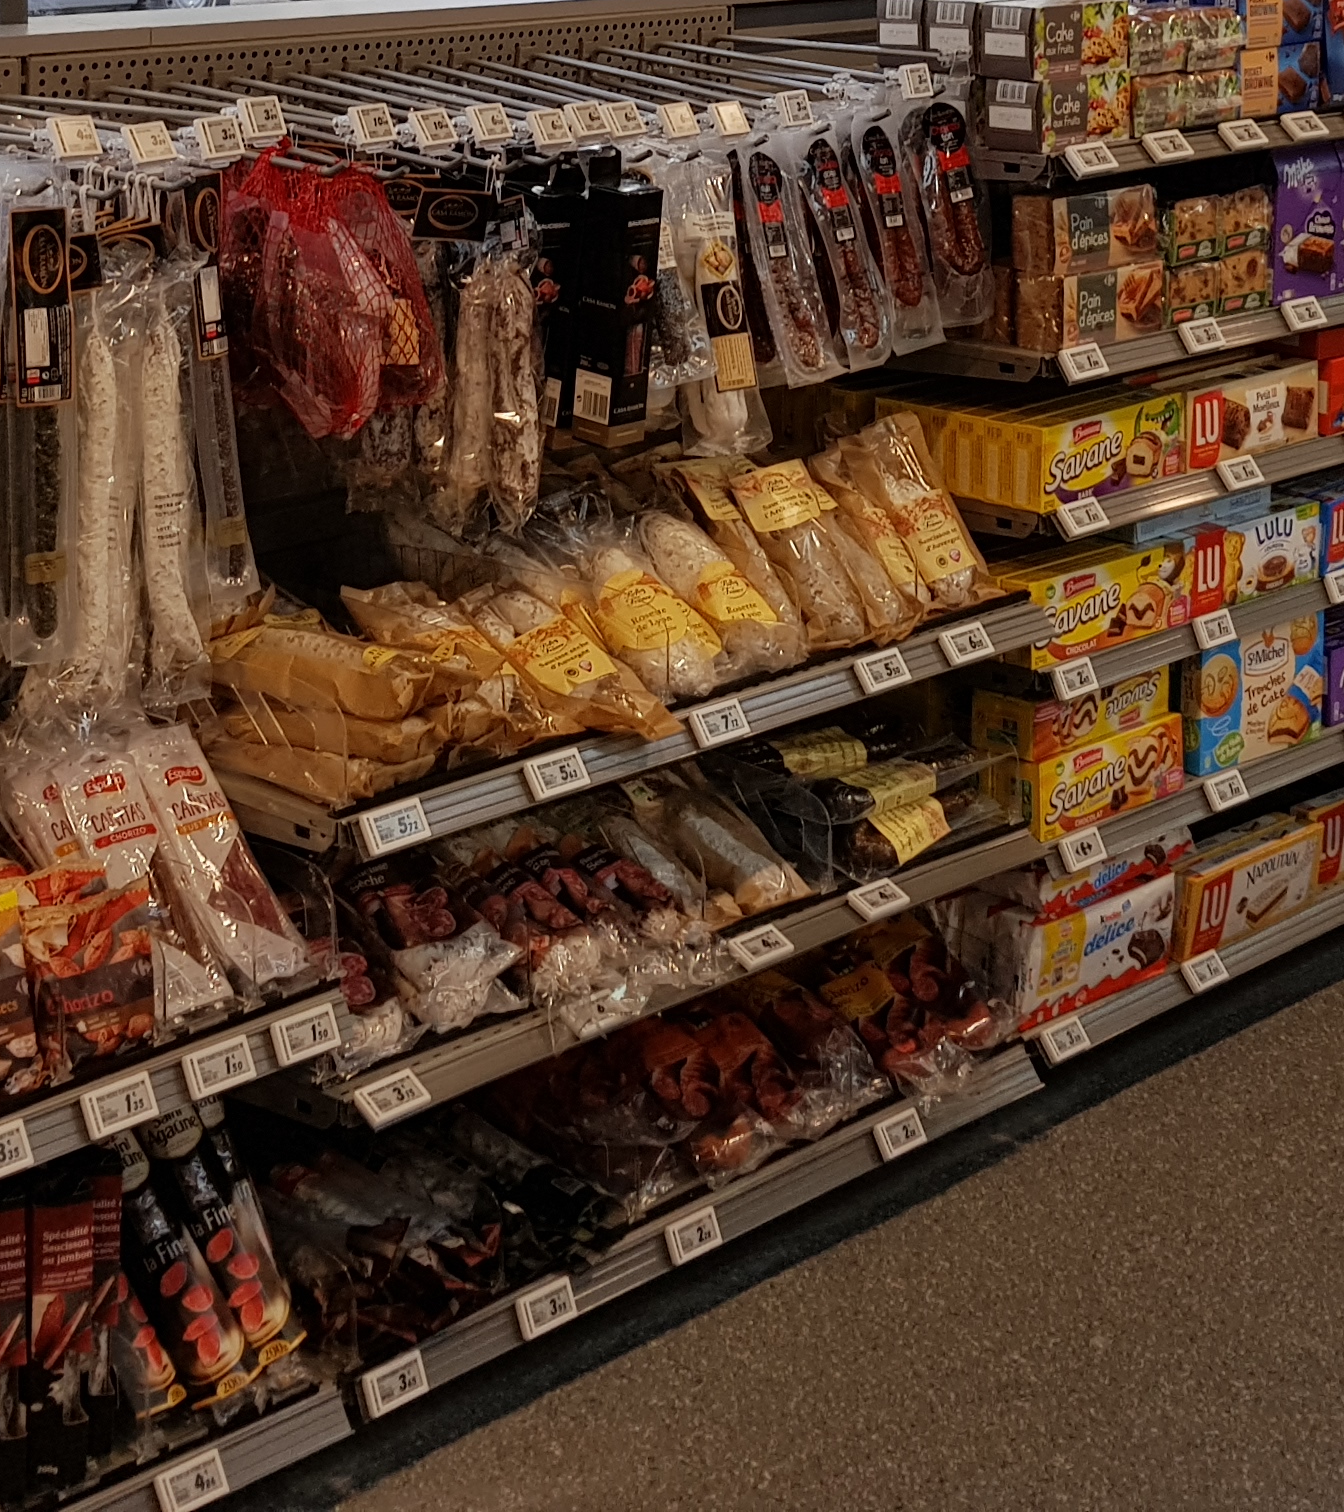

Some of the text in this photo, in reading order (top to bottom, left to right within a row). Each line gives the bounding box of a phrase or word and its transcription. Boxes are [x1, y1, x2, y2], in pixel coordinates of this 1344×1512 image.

[1046, 22, 1074, 43] Cake
[1053, 95, 1081, 116] Cake
[1070, 213, 1094, 231] Pain
[1071, 230, 1109, 250] d'épices
[1079, 290, 1102, 309] Pain
[1079, 307, 1116, 328] d'épices
[1195, 398, 1220, 447] LU
[1044, 431, 1125, 495] Savane
[1255, 517, 1294, 546] LULU
[1198, 544, 1222, 593] LU
[1065, 640, 1098, 657] CHOCOLAT
[1258, 644, 1287, 664] Michel
[1246, 700, 1260, 717] de
[1044, 755, 1127, 825] Savane
[90, 801, 147, 834] CAÑITAS
[1074, 810, 1104, 827] CHOCOLAT
[109, 826, 147, 843] CHORIZO
[1093, 860, 1129, 890] délice
[1246, 851, 1301, 890] NAPOLITAIN
[1199, 880, 1229, 932] LU
[1083, 916, 1136, 958] délice
[42, 1225, 89, 1242] Spécialité
[191, 1220, 204, 1238] la
[42, 1249, 93, 1265] au jambon
